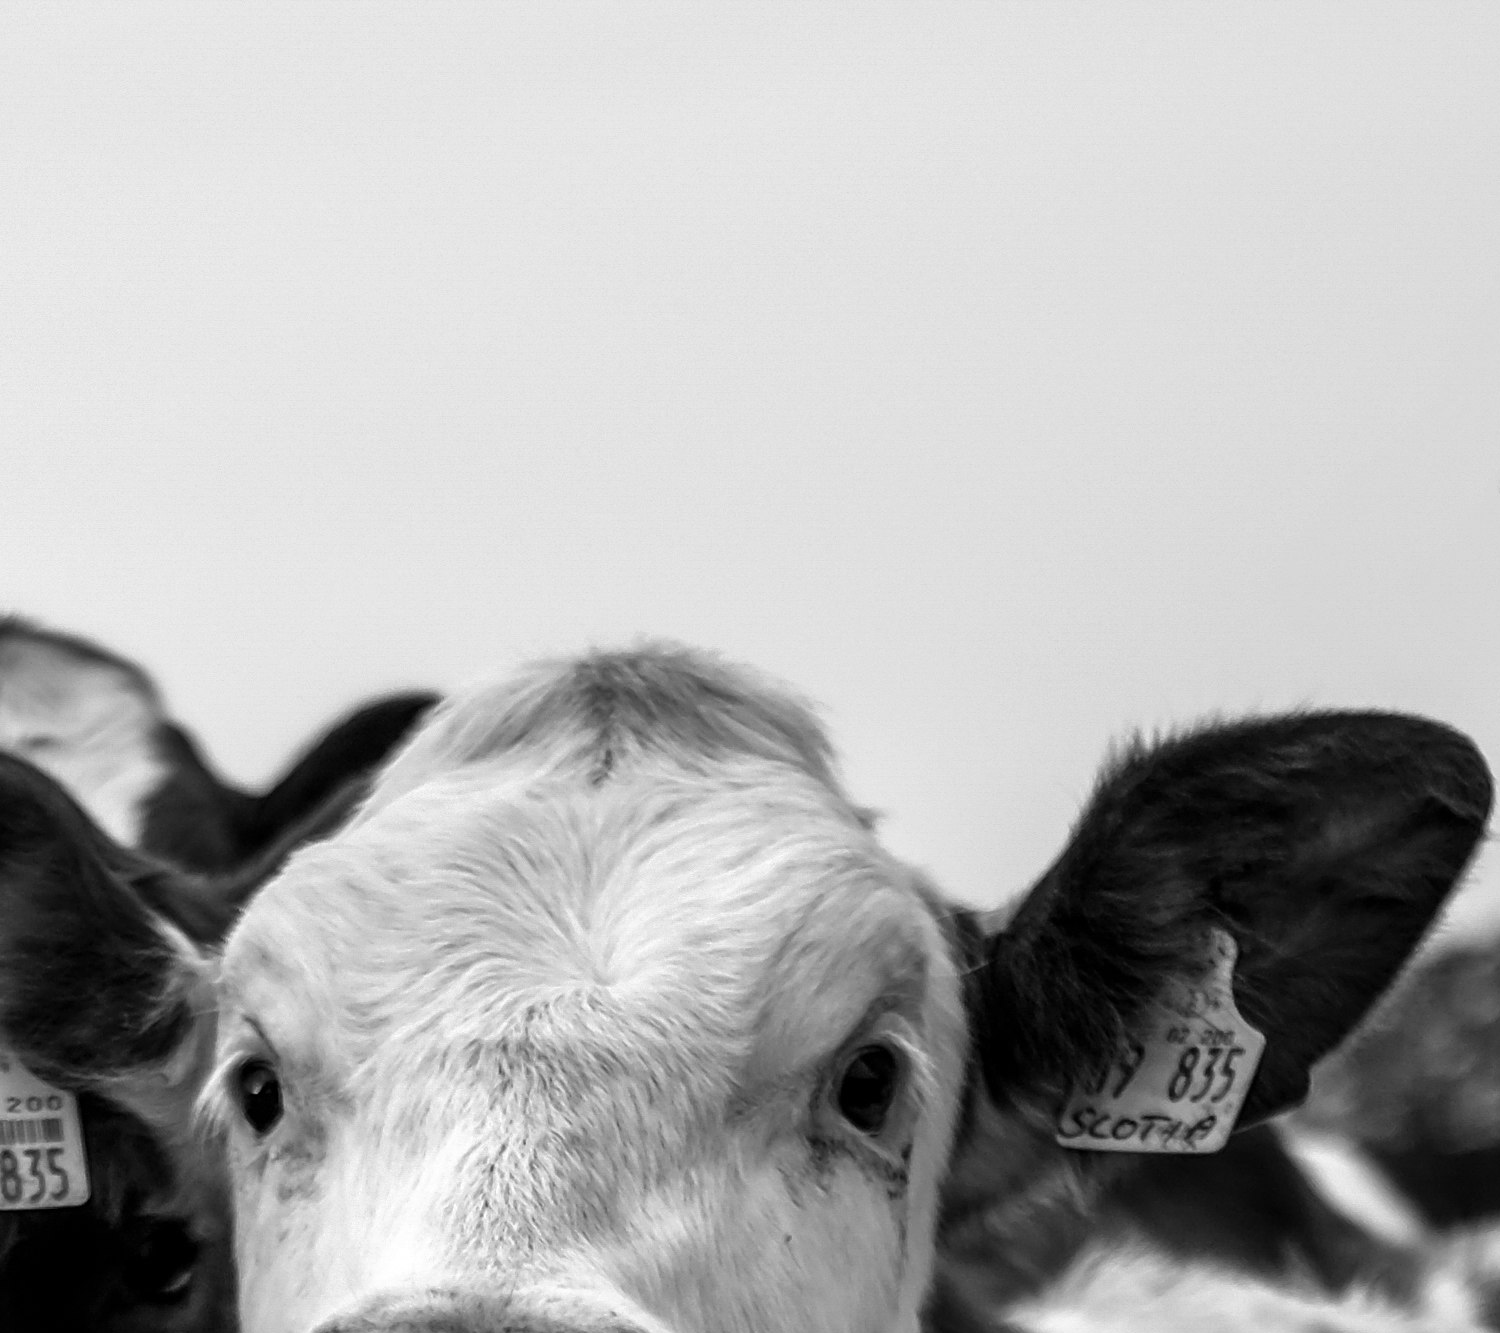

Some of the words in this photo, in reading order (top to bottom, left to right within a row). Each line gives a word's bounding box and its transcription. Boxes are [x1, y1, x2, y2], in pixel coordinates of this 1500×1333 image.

[1168, 1047, 1246, 1103] 835
[7, 1096, 63, 1114] 200
[0, 1148, 70, 1203] 835
